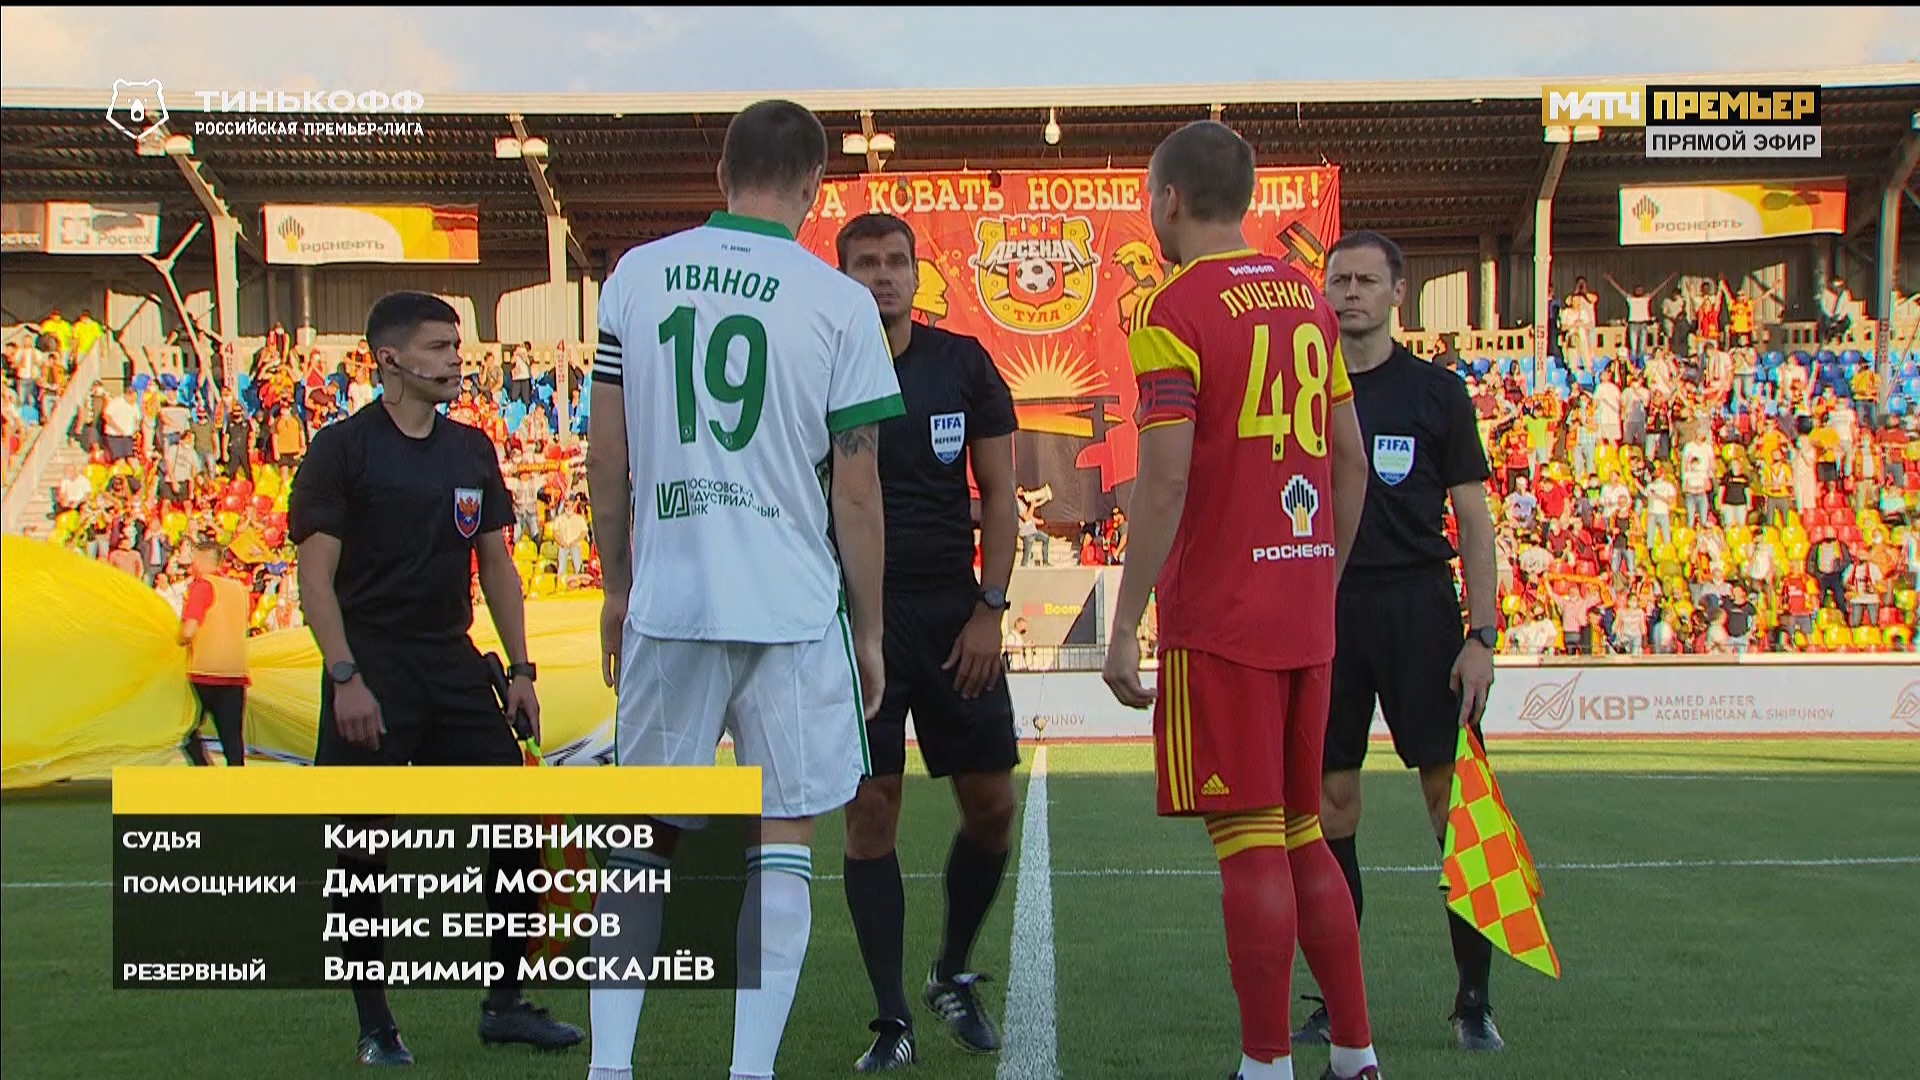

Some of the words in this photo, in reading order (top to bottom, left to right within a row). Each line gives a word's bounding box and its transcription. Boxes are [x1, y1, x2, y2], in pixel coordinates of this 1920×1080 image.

[867, 178, 1005, 214] КОВАТЬ
[1027, 177, 1142, 211] НОВЫЕ
[1655, 219, 1742, 232] РОСНЕФТЬ
[300, 239, 385, 253] РОСНЕФТЬ
[984, 240, 1086, 271] АРСЕНАЛ
[665, 264, 780, 303] ИВАНОВ
[1219, 280, 1315, 318] ЛУЦЕНКО
[1013, 309, 1061, 323] ТУЛА
[658, 305, 768, 452] 19
[1237, 322, 1329, 461] 48
[933, 416, 962, 430] FIFA
[1378, 439, 1411, 452] FIFA
[1252, 543, 1335, 562] РОСНЕФТЬ
[1579, 696, 1650, 721] KBP
[1654, 695, 1704, 706] NAMED
[1709, 695, 1755, 706] AFTER
[1655, 708, 1746, 720] ACADEMICIAN
[1766, 708, 1835, 720] SHIPUNOV
